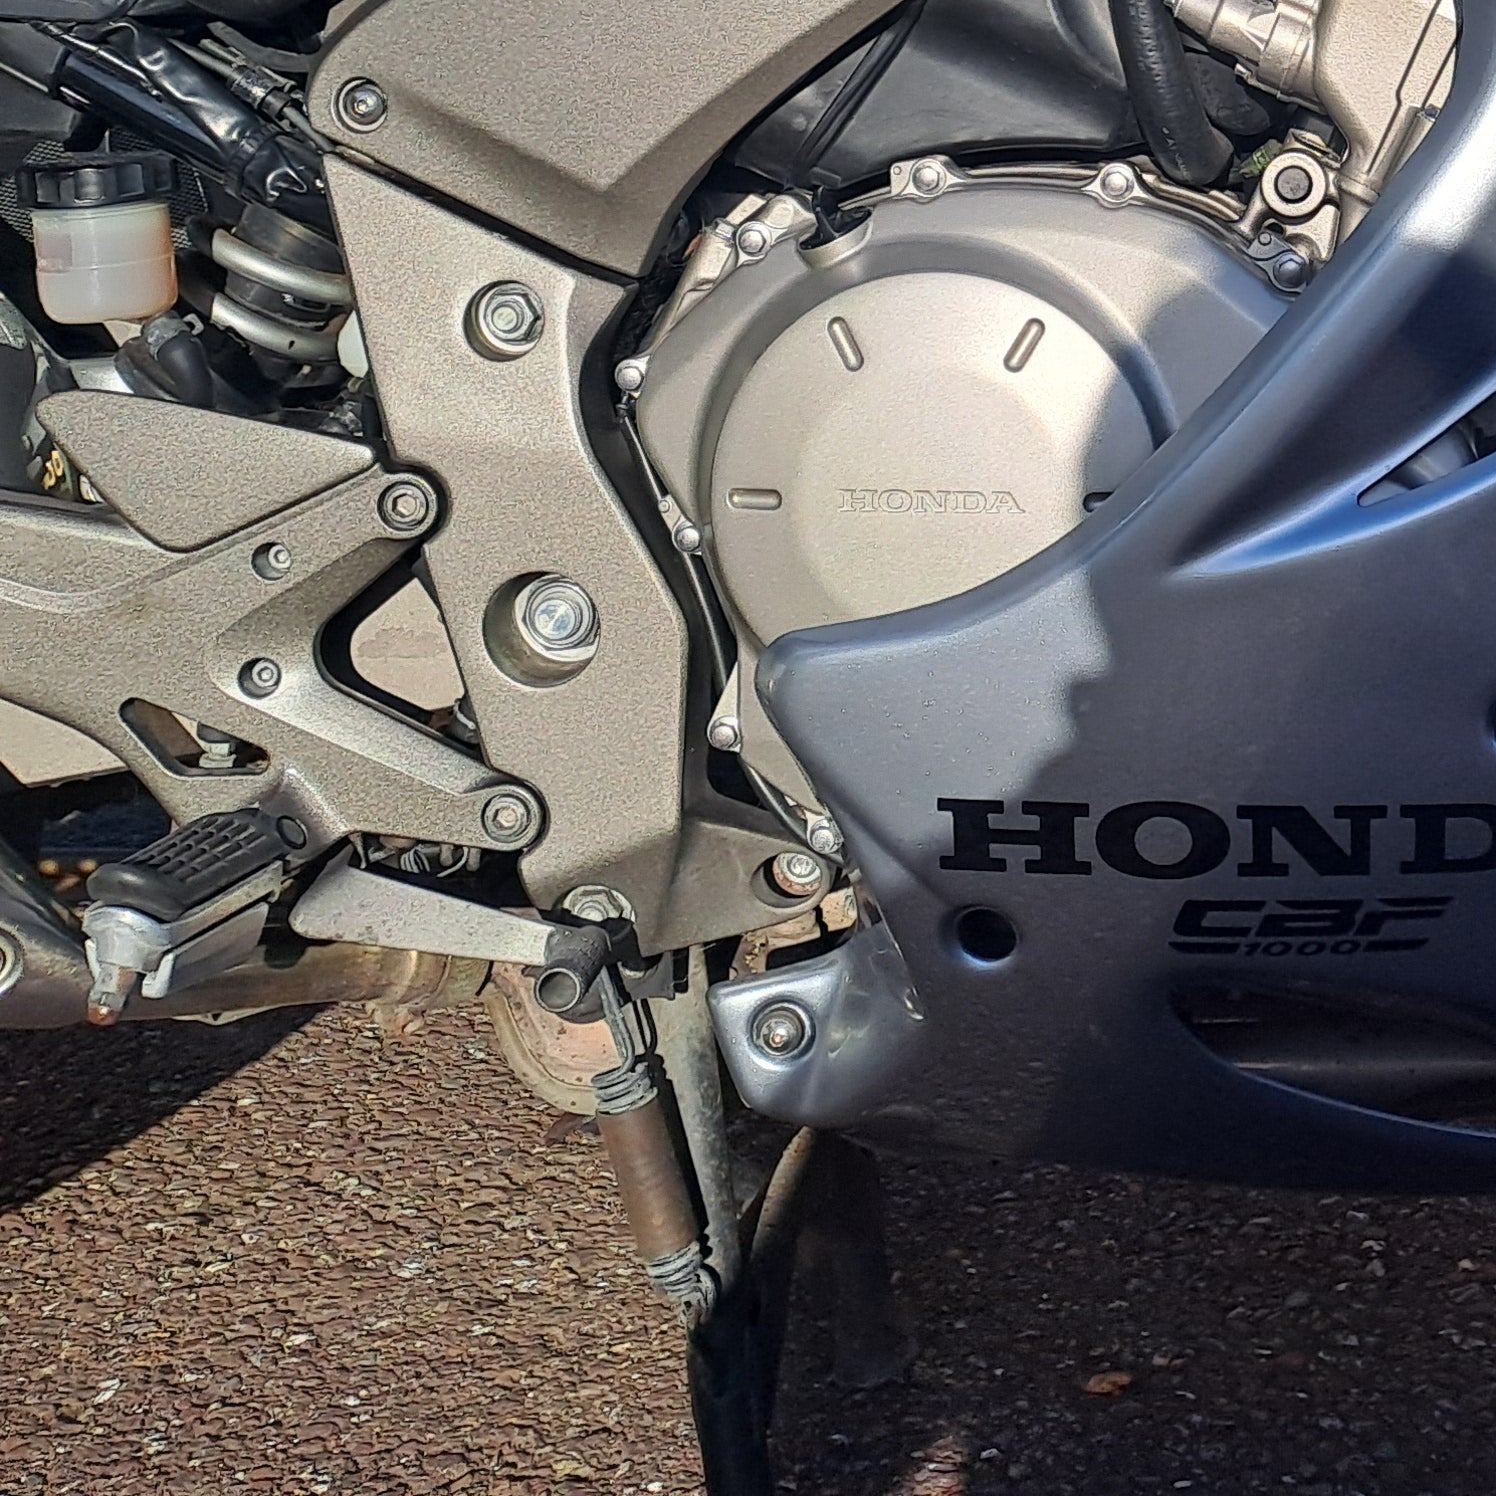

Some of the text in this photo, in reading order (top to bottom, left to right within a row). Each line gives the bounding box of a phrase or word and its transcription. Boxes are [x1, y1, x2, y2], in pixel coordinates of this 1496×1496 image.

[837, 488, 1026, 514] HONDA
[1172, 896, 1454, 939] CBF
[1243, 940, 1364, 958] 1000
